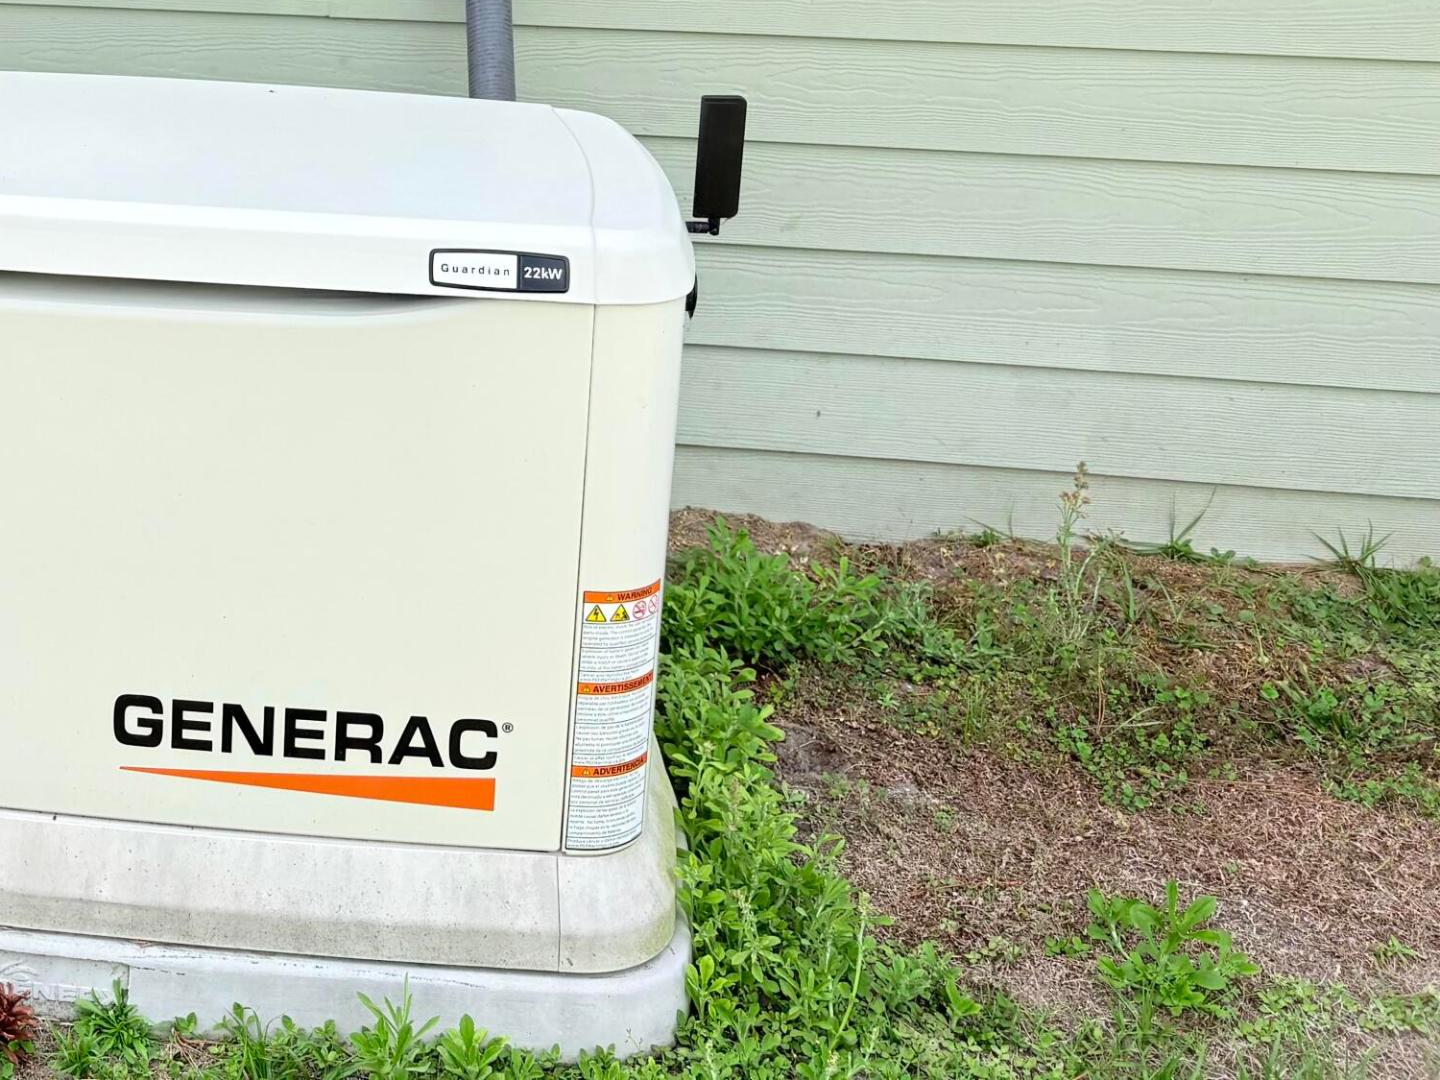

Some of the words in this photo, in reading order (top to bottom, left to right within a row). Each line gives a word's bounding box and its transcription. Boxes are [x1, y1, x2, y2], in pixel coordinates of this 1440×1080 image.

[440, 263, 510, 277] Guardian
[523, 266, 563, 280] 22kW
[617, 587, 652, 601] WARNING
